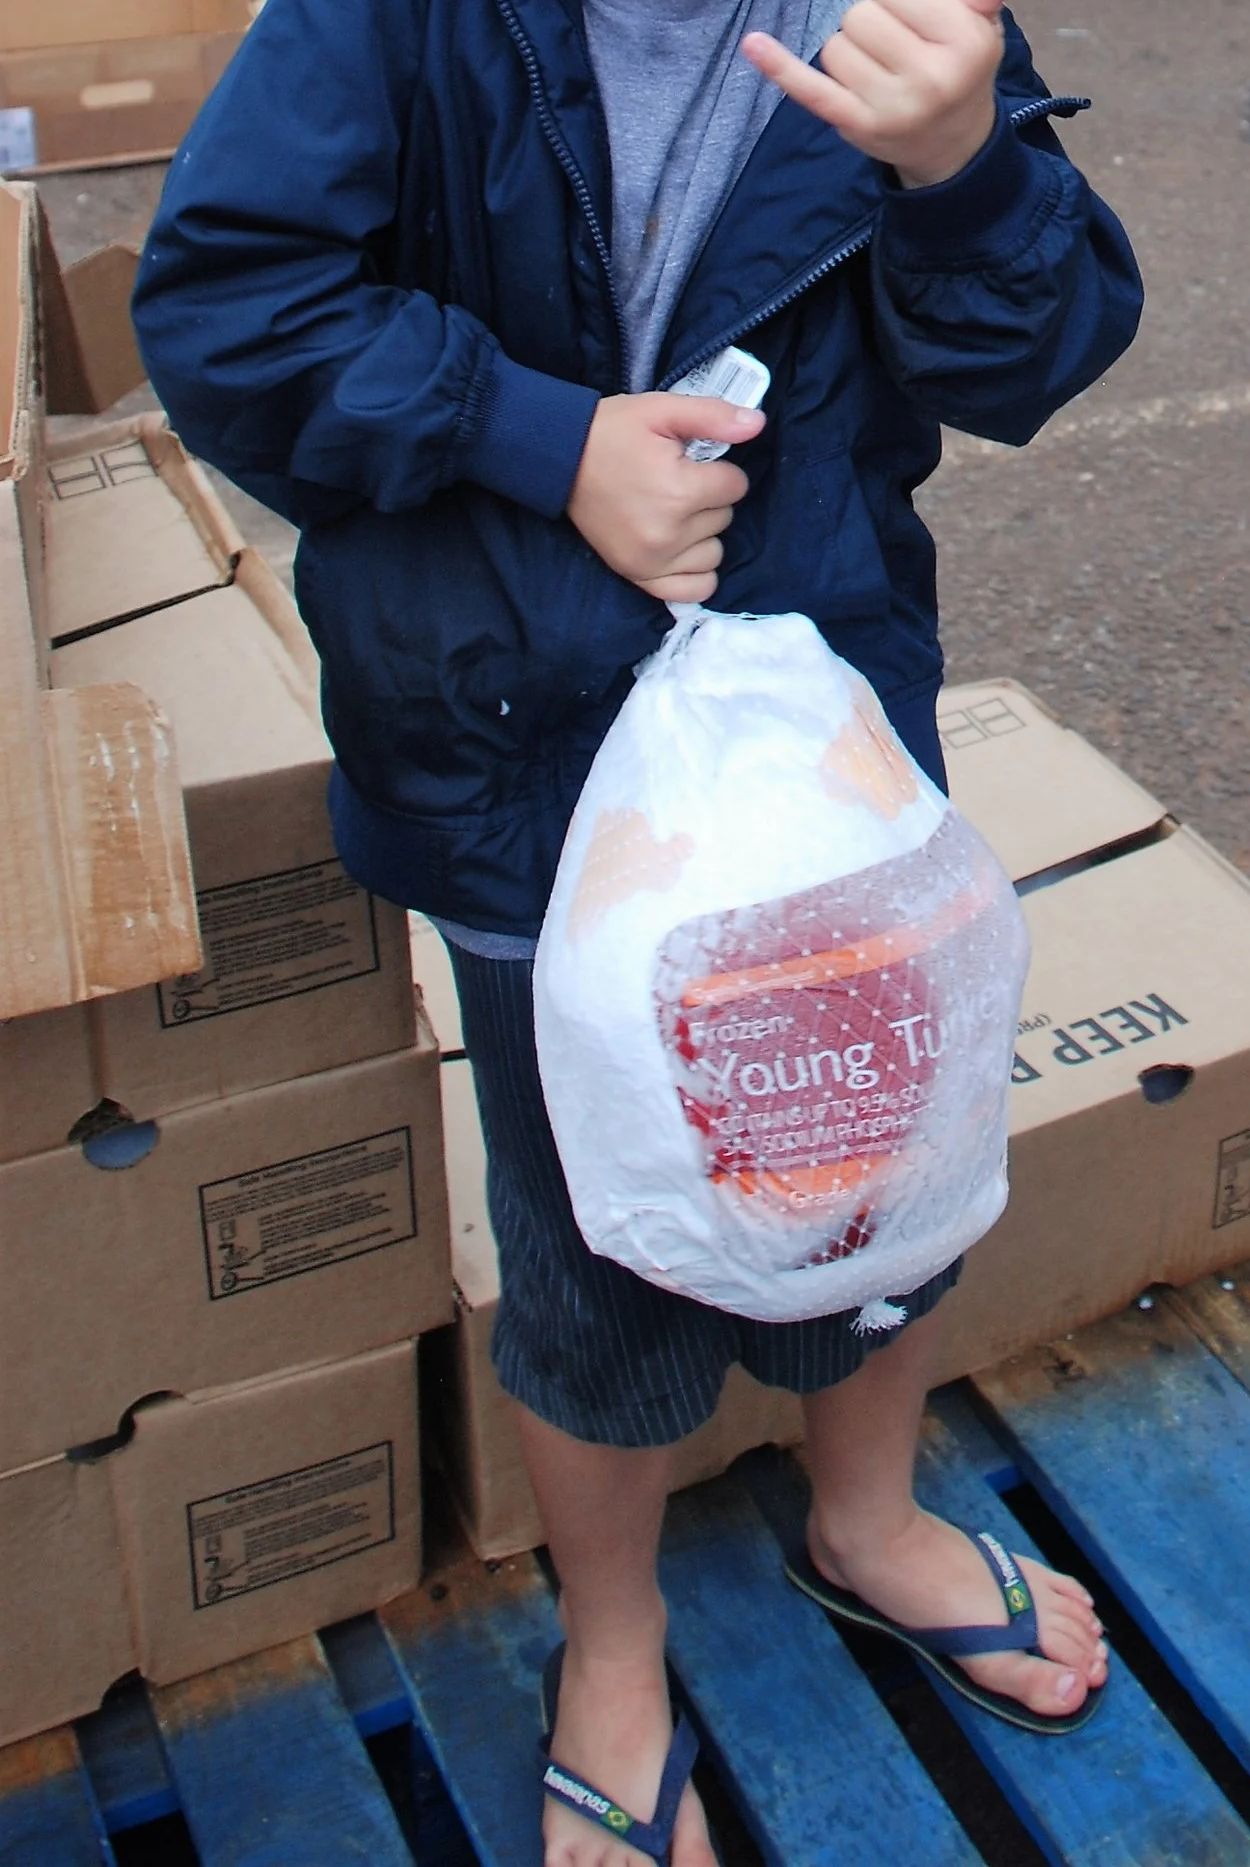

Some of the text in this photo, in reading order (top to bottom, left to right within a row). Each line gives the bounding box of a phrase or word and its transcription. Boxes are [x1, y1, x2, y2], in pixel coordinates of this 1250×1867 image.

[688, 1015, 788, 1047] Frozen
[1052, 992, 1189, 1066] KEEP
[696, 1040, 880, 1099] Young
